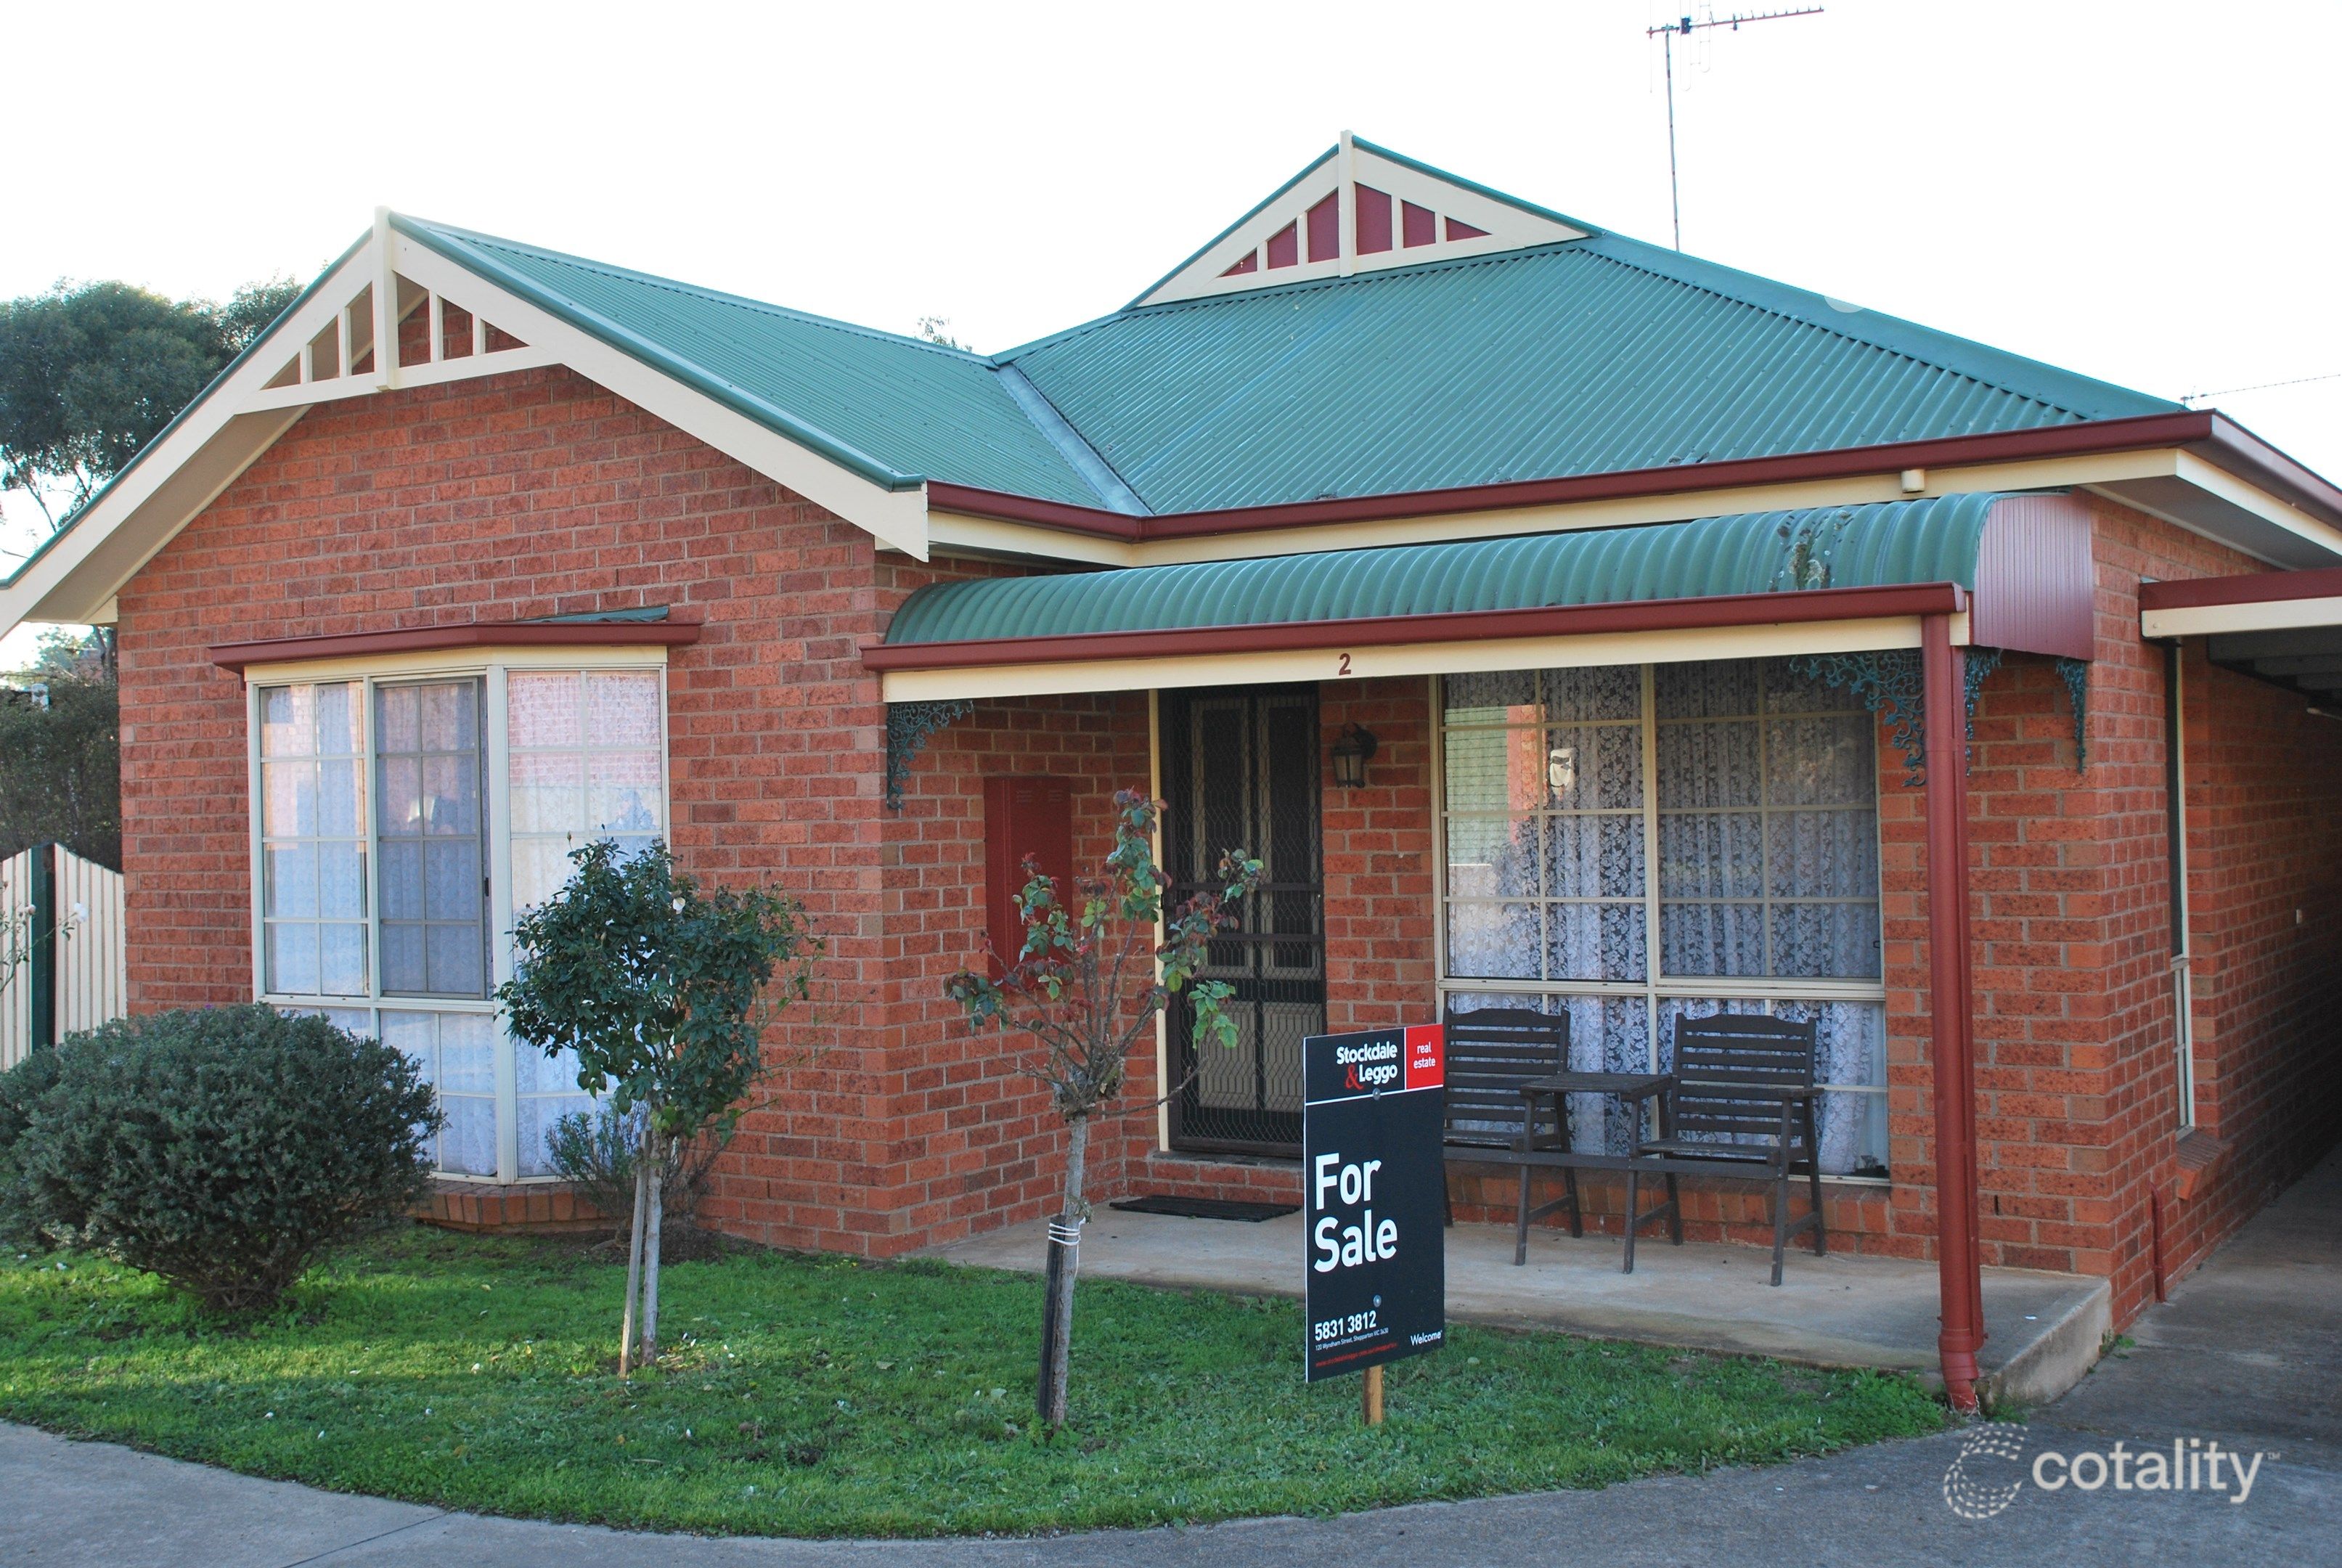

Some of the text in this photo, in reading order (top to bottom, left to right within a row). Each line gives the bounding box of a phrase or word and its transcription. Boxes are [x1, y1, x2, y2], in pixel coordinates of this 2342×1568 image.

[1339, 653, 1352, 676] 2
[1336, 1040, 1398, 1065] Stockdale
[1416, 1042, 1432, 1054] real
[1358, 1063, 1398, 1085] Leggo
[1413, 1056, 1436, 1069] estate
[1315, 1152, 1382, 1210] For
[1314, 1209, 1398, 1273] Sale
[1315, 1310, 1376, 1342] 5831 3812
[1410, 1331, 1442, 1346] Welcome
